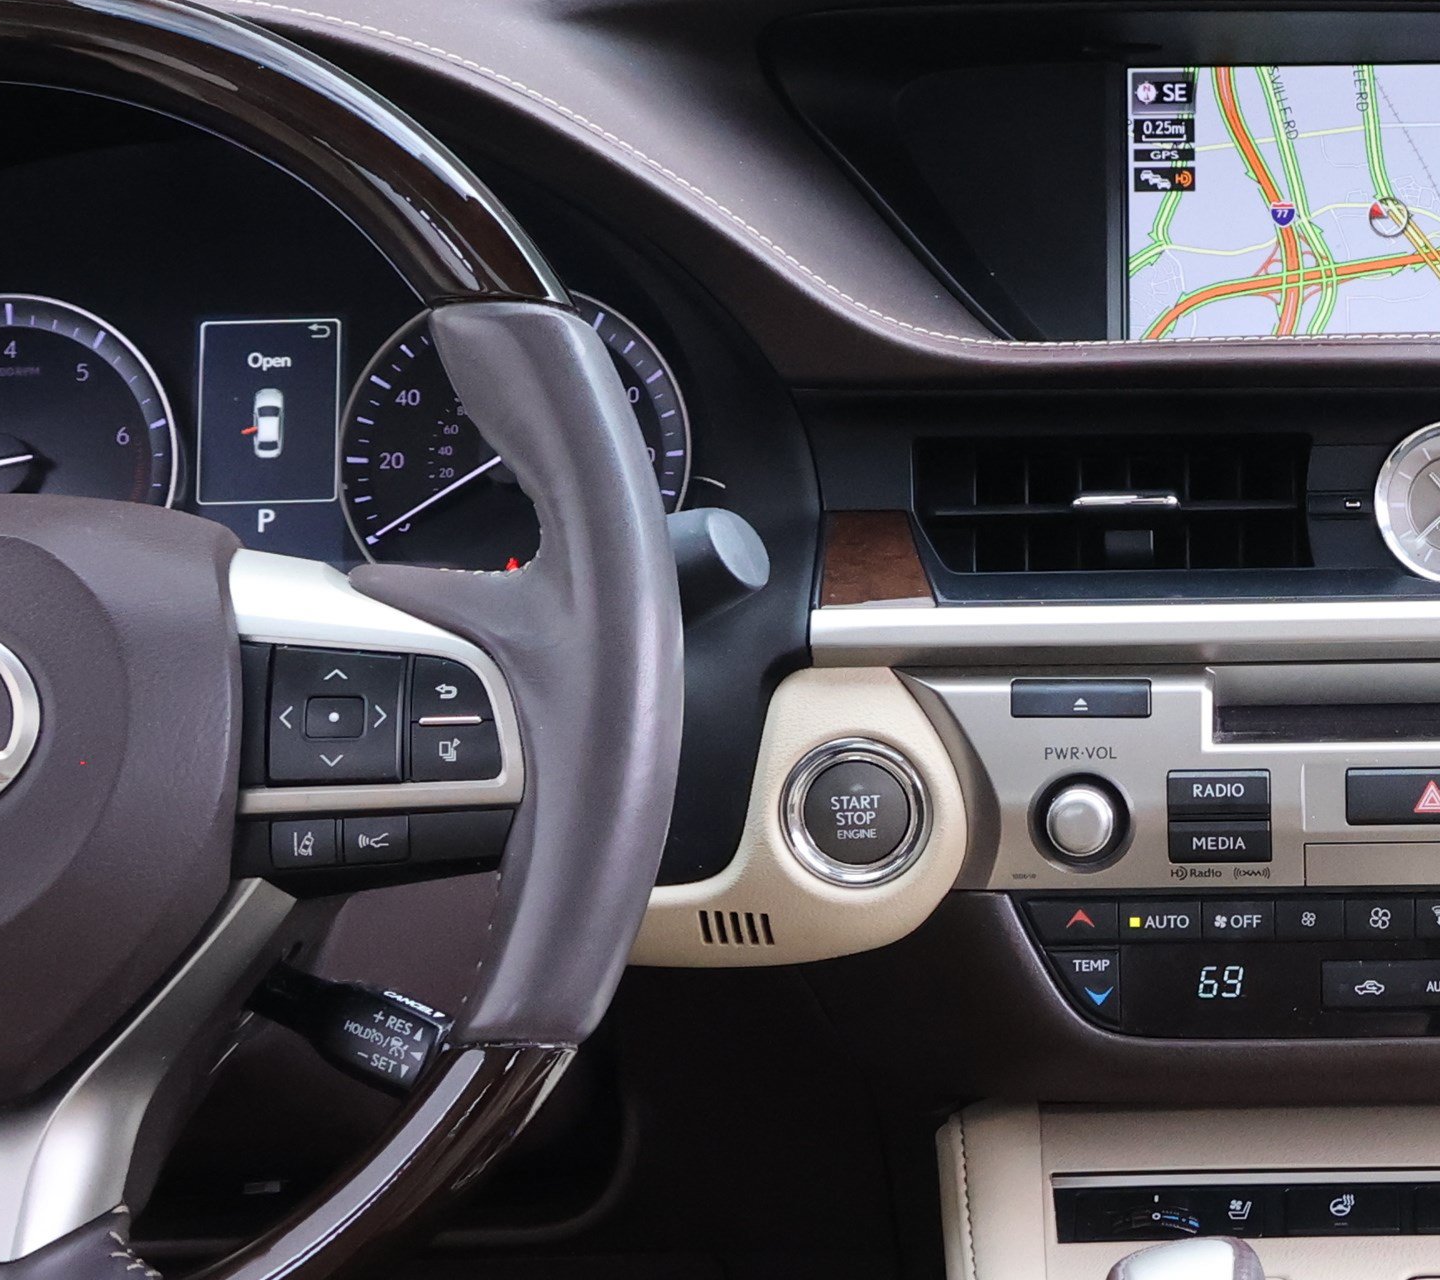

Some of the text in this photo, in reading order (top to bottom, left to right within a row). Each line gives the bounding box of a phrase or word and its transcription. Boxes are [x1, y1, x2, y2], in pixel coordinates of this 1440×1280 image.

[1162, 83, 1188, 102] SE
[1356, 89, 1369, 112] RD
[1142, 122, 1186, 136] 0.25mi
[1283, 120, 1300, 141] RD
[1149, 150, 1180, 160] GPS
[1276, 209, 1290, 219] 77
[3, 339, 17, 358] 4
[247, 352, 292, 371] Open
[75, 362, 90, 382] 5
[395, 388, 421, 407] 40
[116, 426, 130, 445] 6
[443, 423, 459, 436] 60
[437, 445, 453, 457] 40
[379, 451, 405, 470] 20
[438, 466, 455, 480] 20
[256, 509, 276, 533] P
[1192, 783, 1245, 798] RADIO
[830, 795, 881, 810] START
[835, 811, 877, 826] STOP
[836, 828, 877, 840] ENGINE
[1192, 836, 1247, 850] MEDIA
[1189, 867, 1222, 880] Radio
[1145, 915, 1190, 929] AUTO
[1230, 915, 1262, 929] OFF
[1072, 959, 1110, 972] TEMP
[1197, 965, 1245, 998] 69
[383, 991, 434, 1016] CANCEL
[344, 1019, 372, 1039] HOLD
[385, 1014, 414, 1036] RES
[370, 1053, 398, 1074] SET
